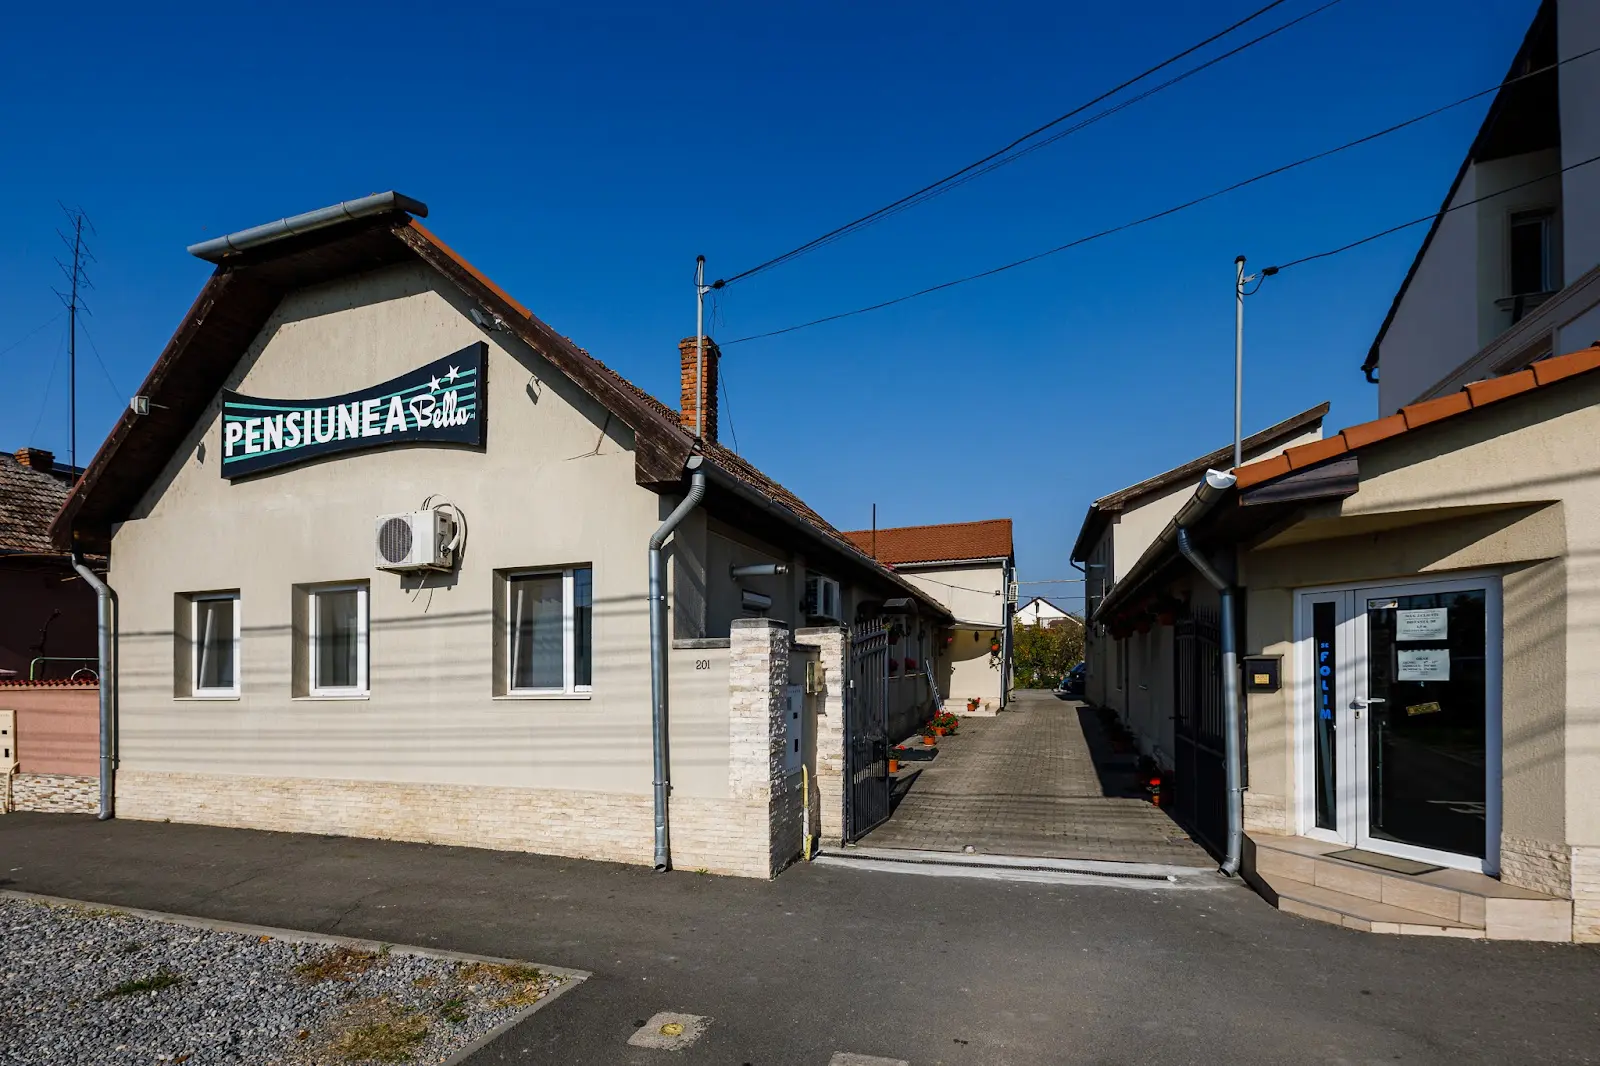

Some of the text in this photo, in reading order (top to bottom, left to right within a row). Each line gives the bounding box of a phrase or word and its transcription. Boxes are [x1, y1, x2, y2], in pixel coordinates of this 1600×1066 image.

[225, 390, 471, 457] PENSIUNEA Bella
[695, 659, 710, 670] 201
